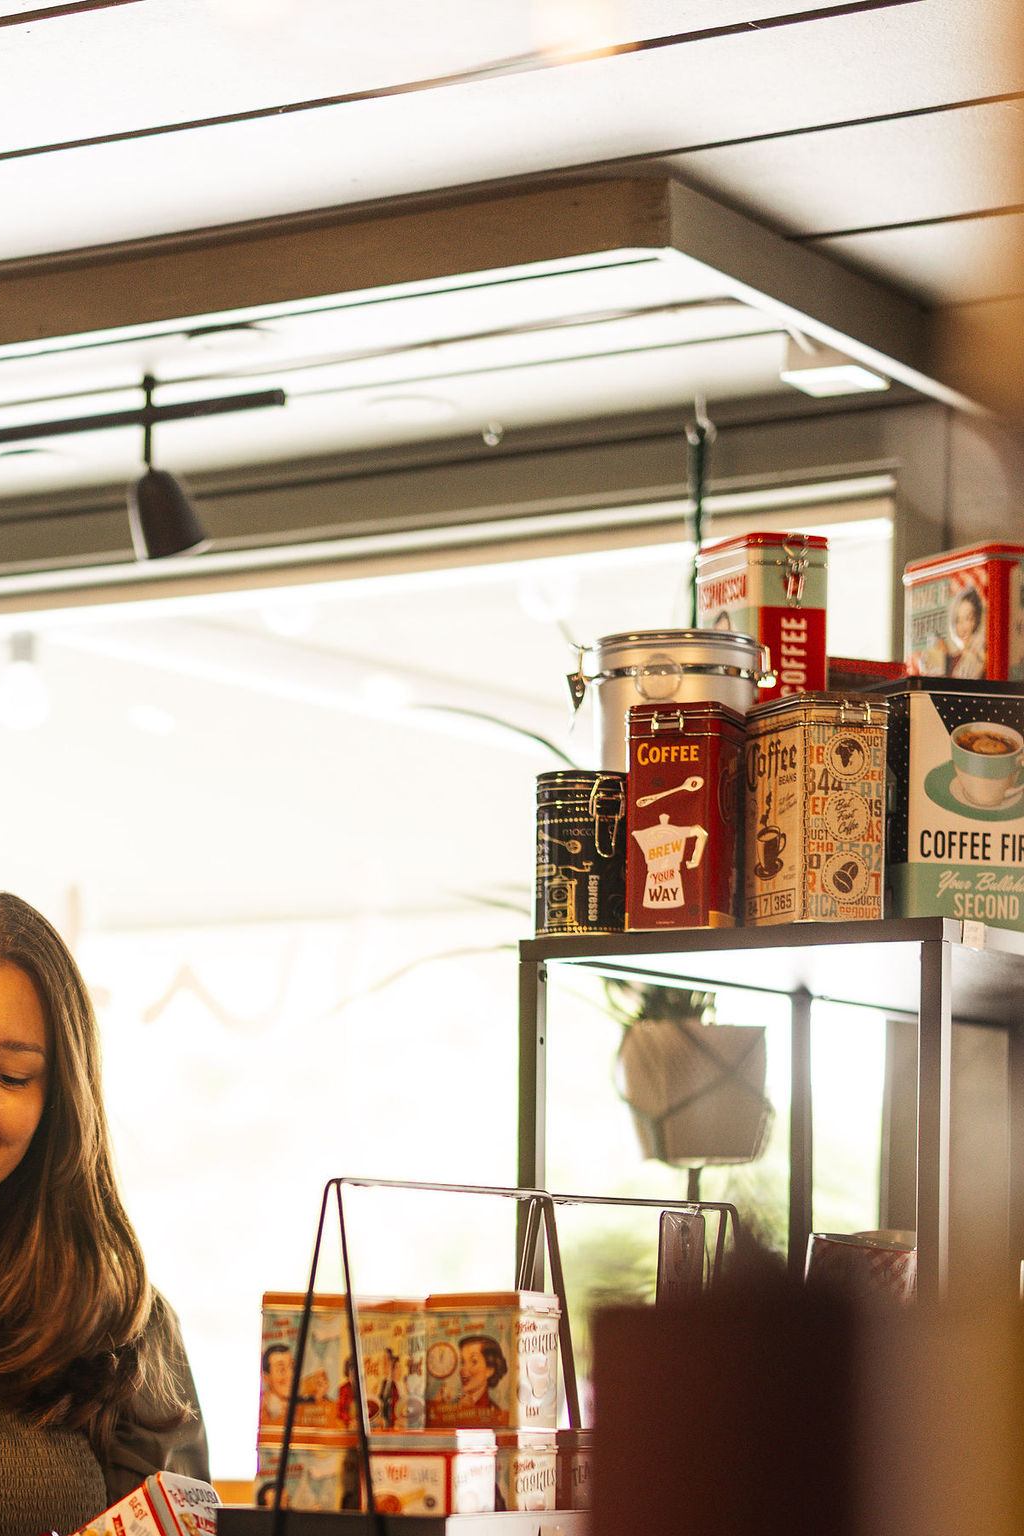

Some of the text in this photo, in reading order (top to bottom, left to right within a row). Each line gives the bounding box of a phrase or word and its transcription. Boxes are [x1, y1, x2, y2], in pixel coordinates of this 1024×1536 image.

[780, 617, 807, 699] COFFEE
[637, 743, 699, 766] COFFEE
[746, 738, 798, 793] Coffee
[778, 772, 798, 787] BEANS
[648, 839, 683, 860] BREW
[920, 829, 991, 861] COFFEE
[650, 869, 675, 885] YOUR
[936, 870, 972, 898] Your
[587, 874, 600, 922] Espresso
[648, 886, 679, 902] WAY
[774, 893, 793, 912] 365
[953, 892, 1019, 920] SECOND
[128, 1495, 148, 1520] BEST
